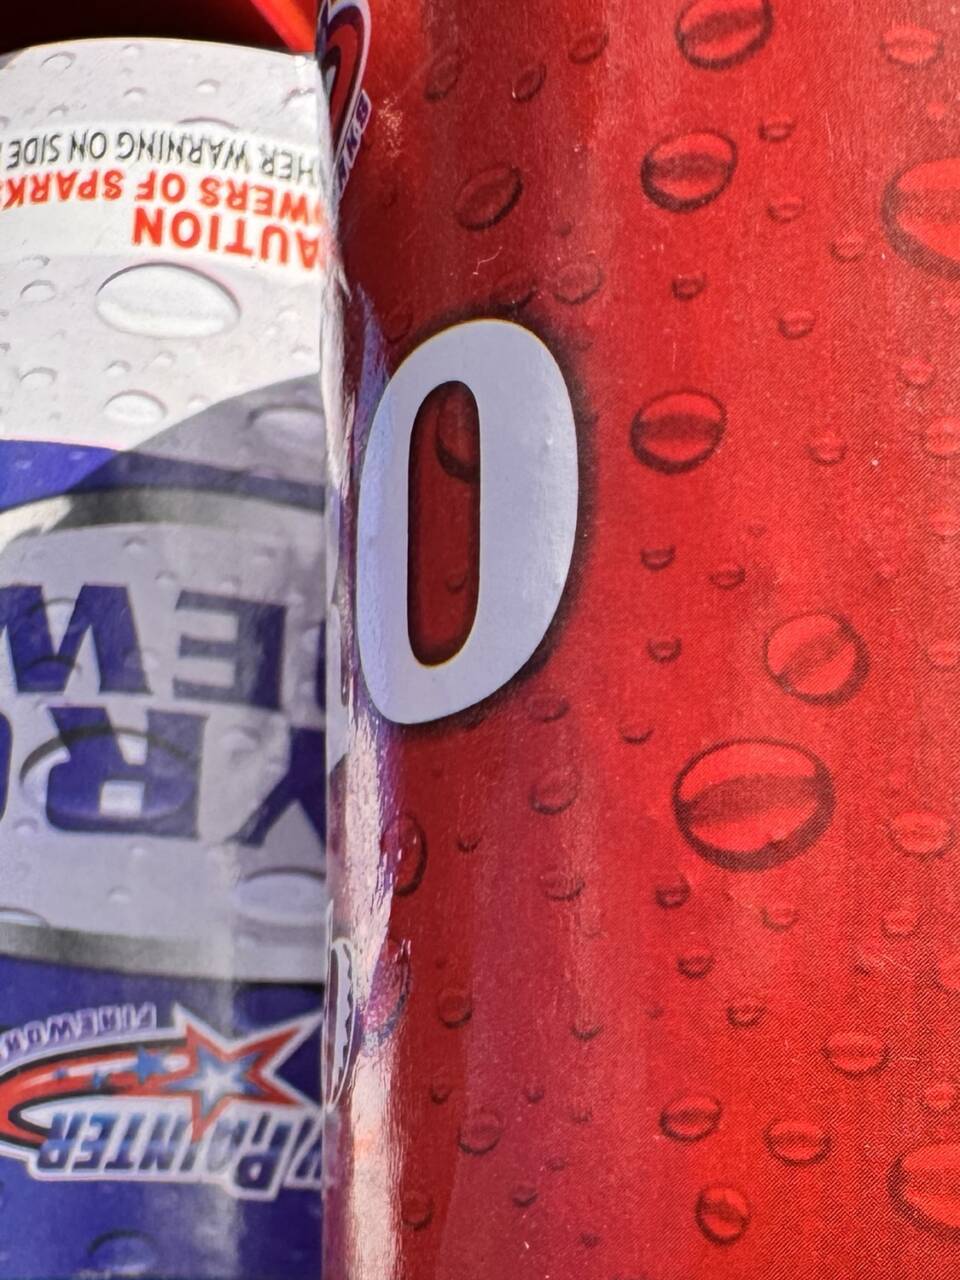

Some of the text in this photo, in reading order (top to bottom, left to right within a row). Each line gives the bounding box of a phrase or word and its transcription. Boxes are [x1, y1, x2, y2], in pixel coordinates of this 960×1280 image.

[6, 134, 62, 170] SIDE
[68, 130, 107, 162] ON
[117, 130, 250, 173] WARNING
[1, 170, 124, 211] SPARK
[135, 170, 186, 203] OF
[132, 206, 324, 270] AUTION
[0, 583, 326, 711] EW
[0, 705, 326, 851] YR
